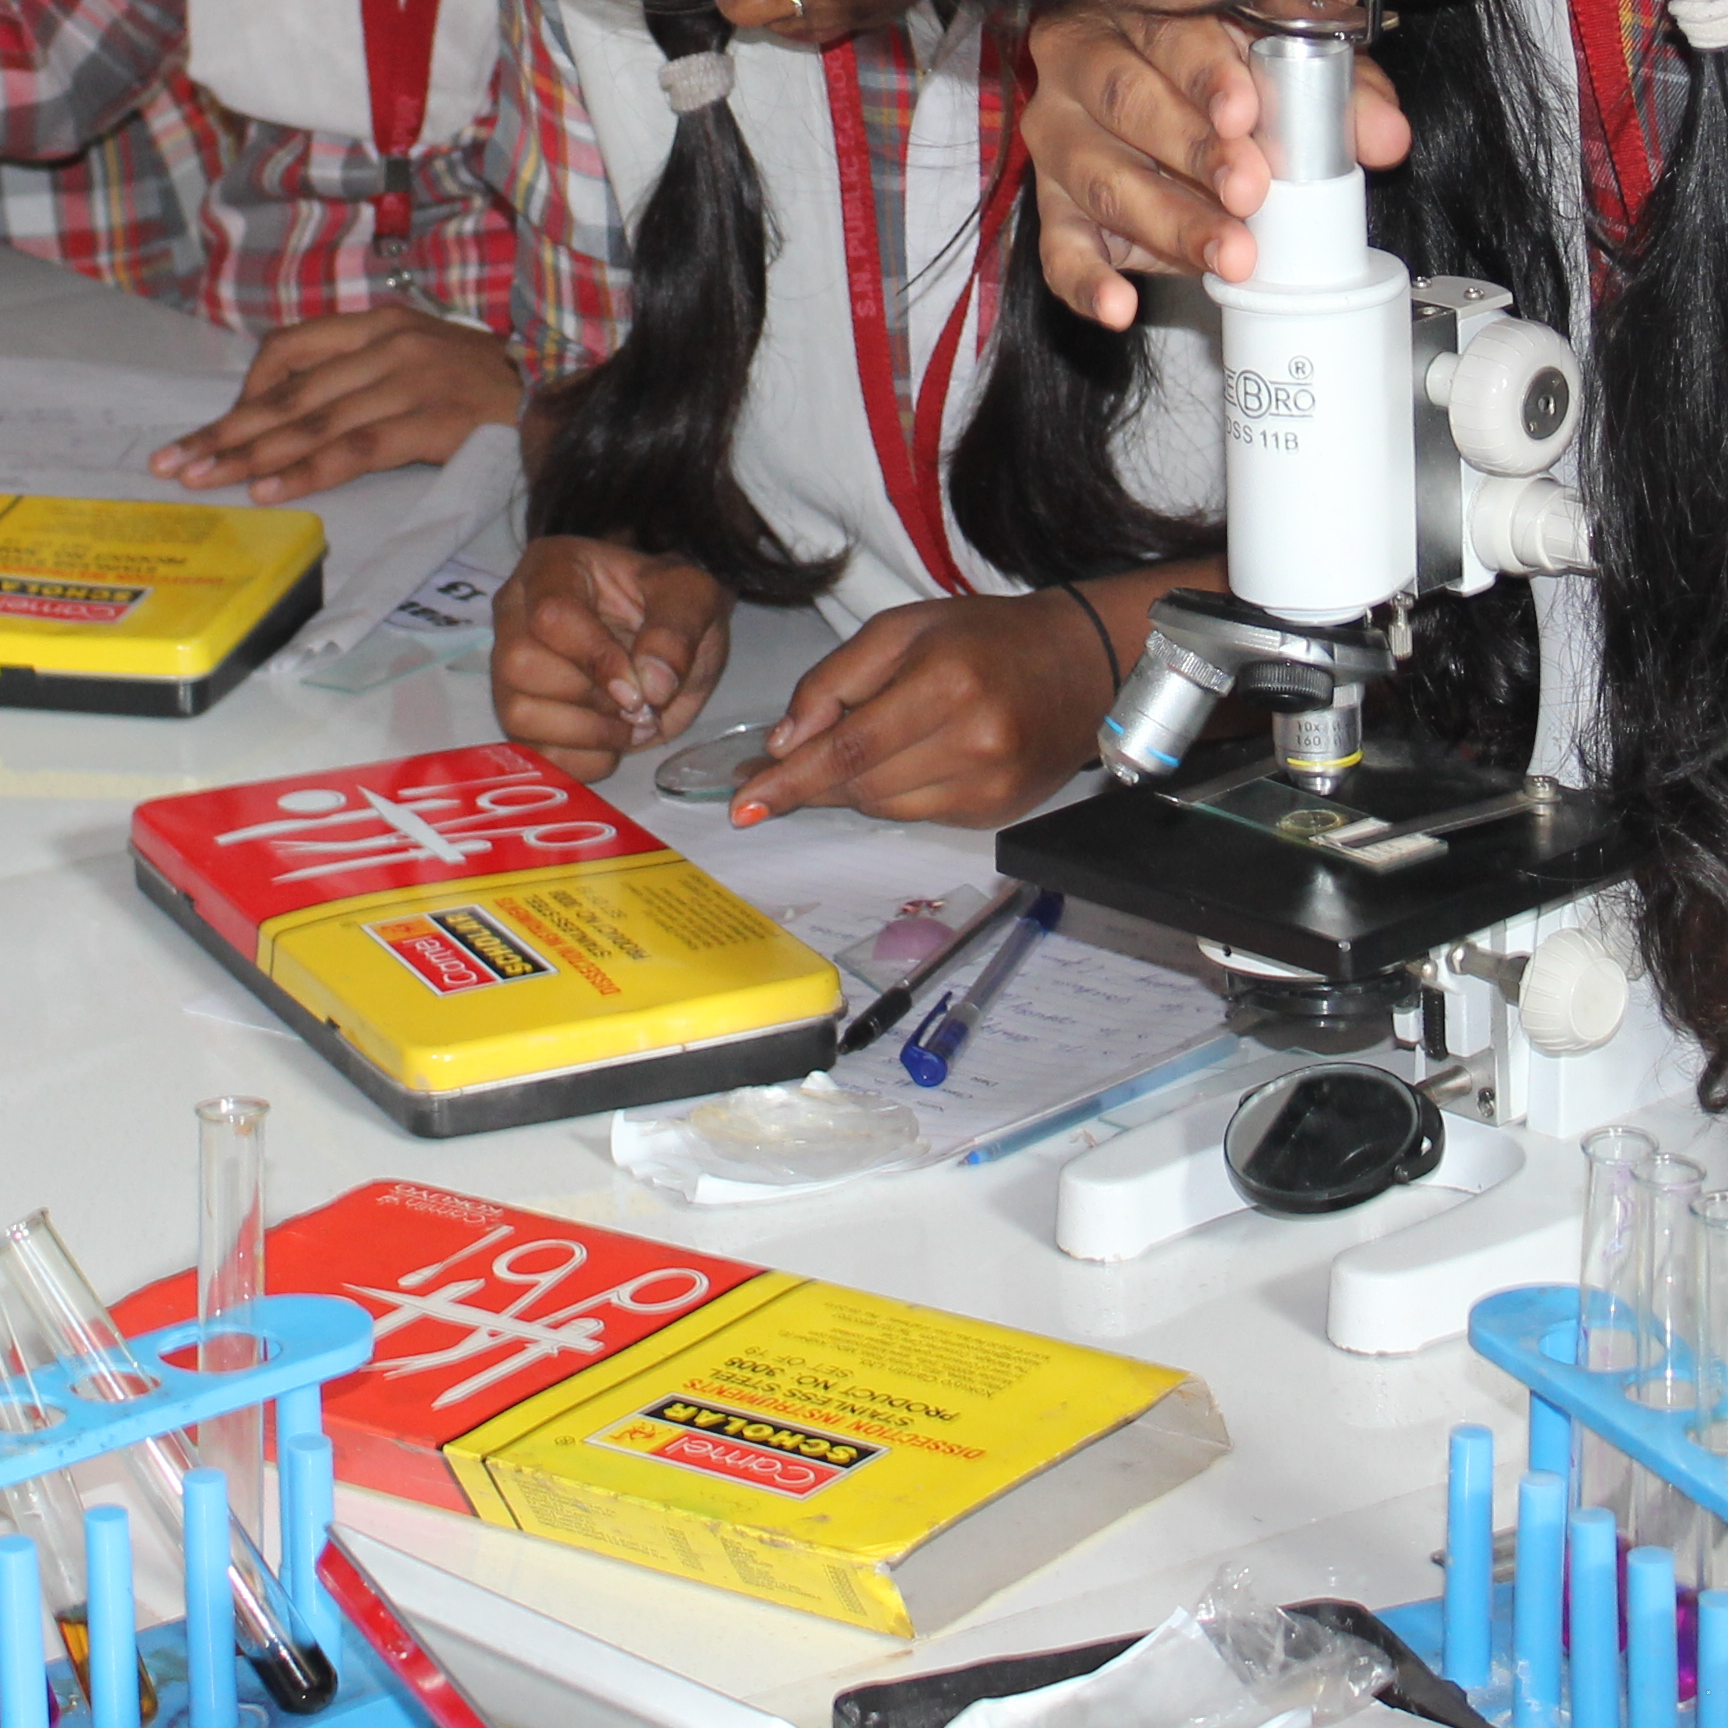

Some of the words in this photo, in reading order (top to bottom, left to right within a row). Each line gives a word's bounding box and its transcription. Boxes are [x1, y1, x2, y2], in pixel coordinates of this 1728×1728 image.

[826, 48, 856, 147] SCHOO
[840, 158, 869, 257] PUBLIC
[1259, 429, 1299, 452] 11B
[403, 937, 481, 987] Camel
[443, 912, 534, 976] SCHOLAR
[699, 1367, 784, 1392] STEEL
[720, 1356, 787, 1376] 3008
[769, 1353, 811, 1366] OF
[805, 1362, 856, 1378] SET
[679, 1377, 848, 1424] INSTRUMENTS
[777, 1387, 918, 1427] STAINLESS
[837, 1385, 963, 1420] PRODUCT
[660, 1400, 862, 1464] SCHOLAR
[843, 1419, 986, 1460] DISSECTION
[663, 1435, 821, 1490] Camel
